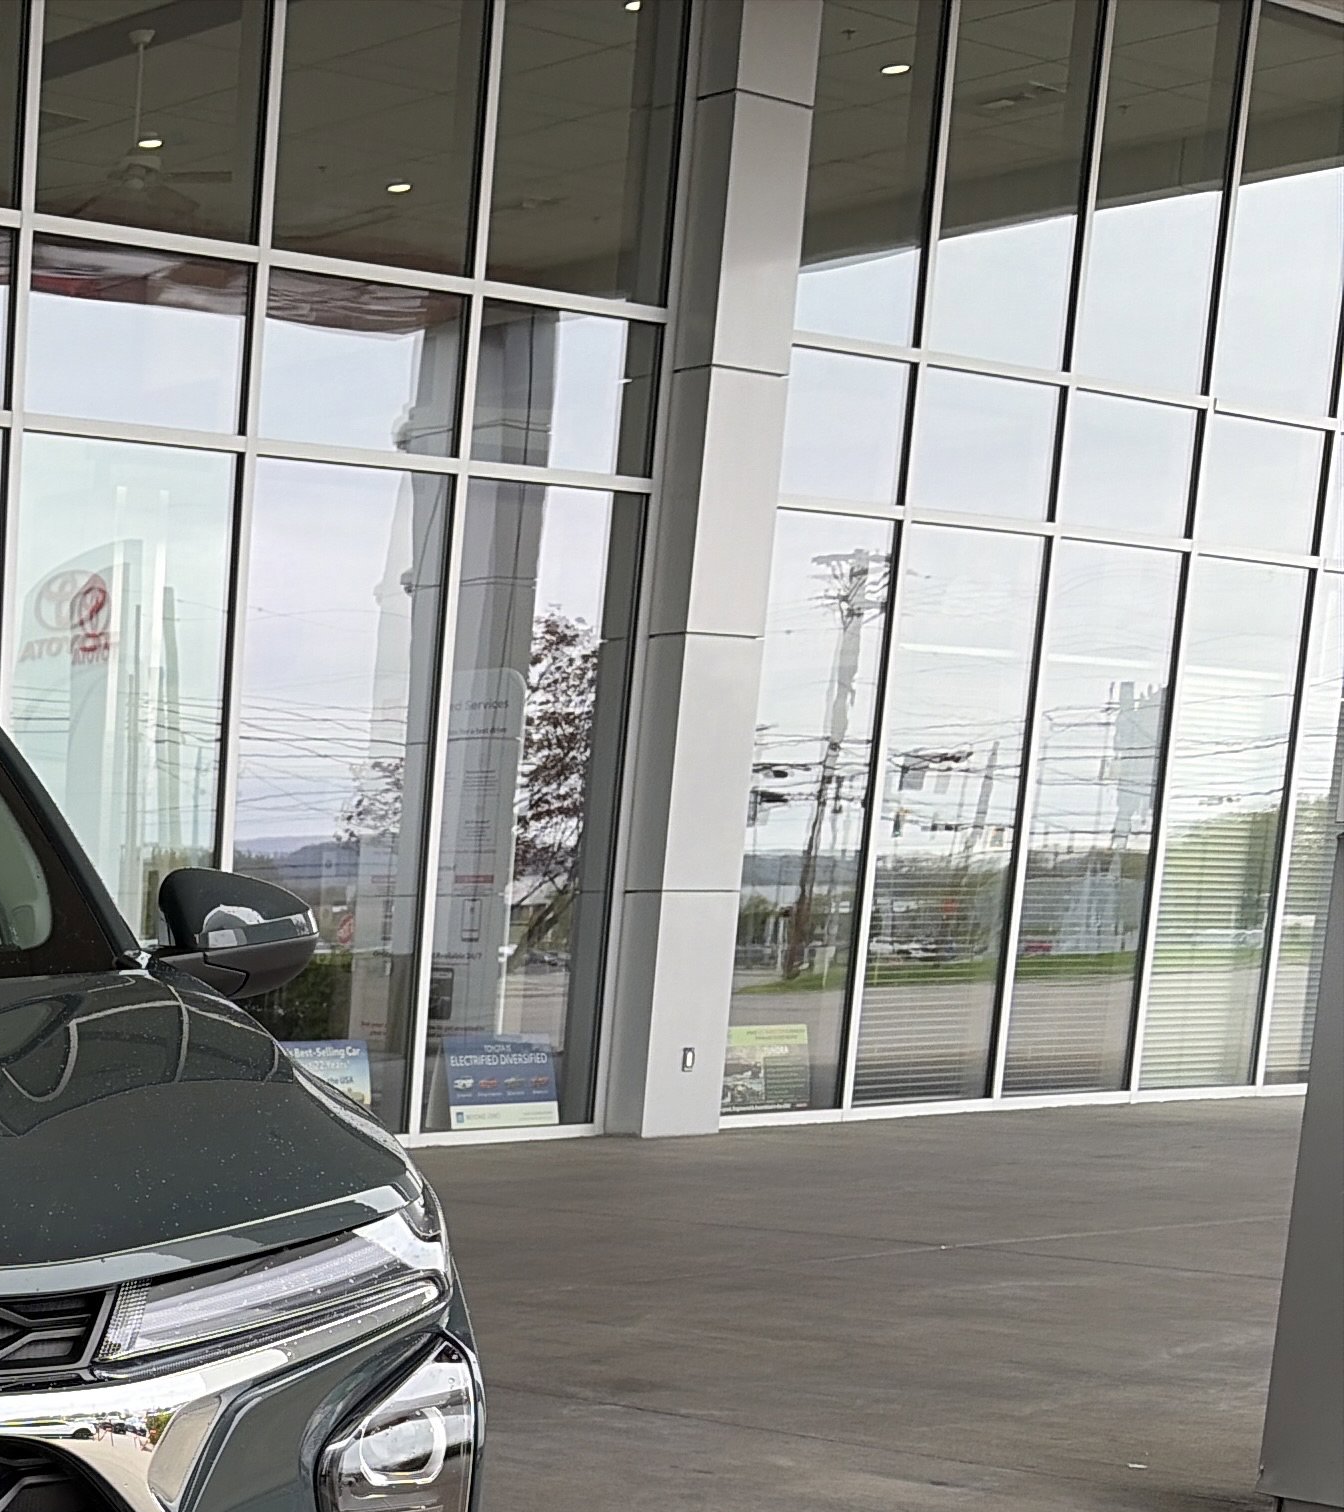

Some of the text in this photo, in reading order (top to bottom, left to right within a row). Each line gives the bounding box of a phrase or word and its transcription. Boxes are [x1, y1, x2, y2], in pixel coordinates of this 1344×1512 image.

[346, 1046, 361, 1057] Car
[450, 1053, 548, 1067] ELECTRIFIED DIVERSIFIED
